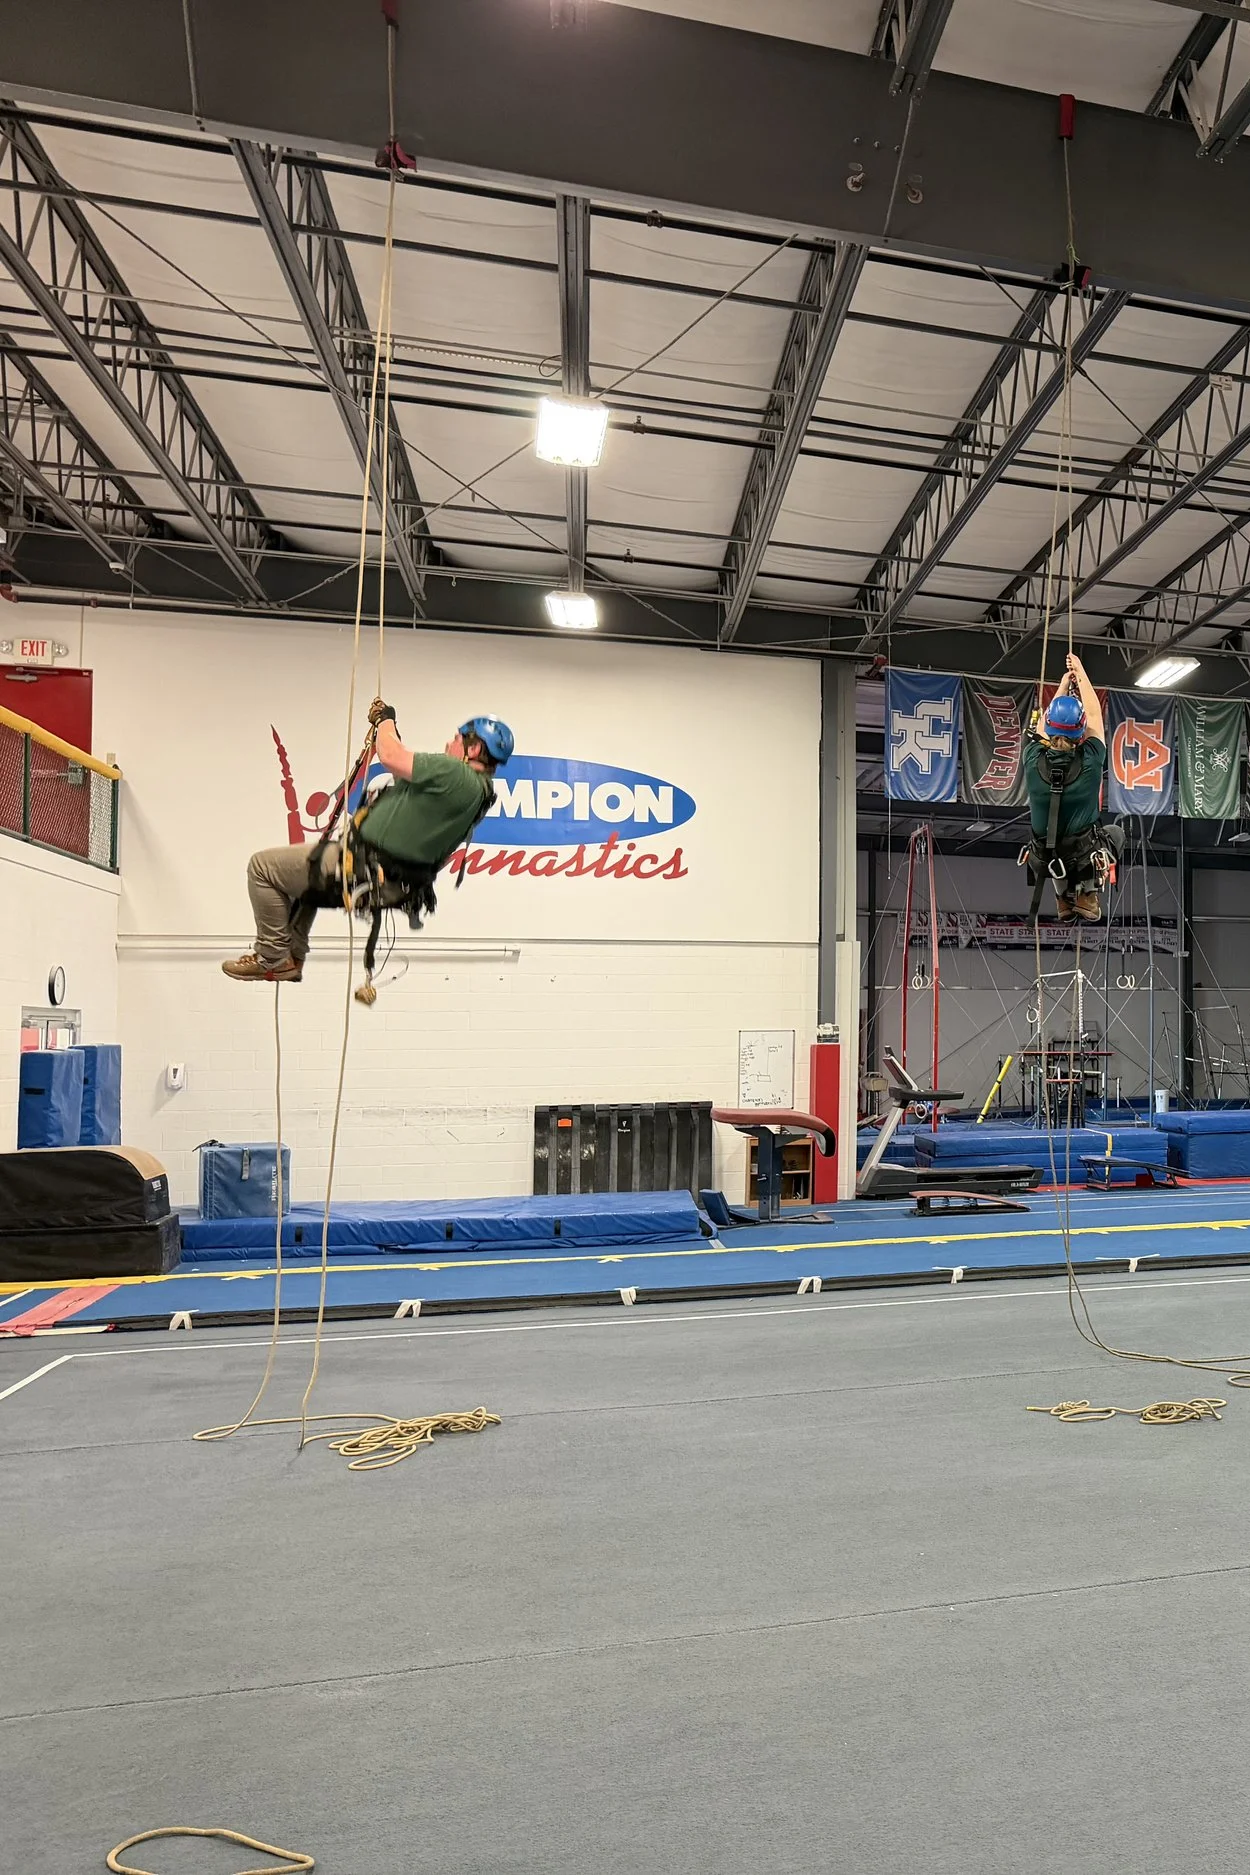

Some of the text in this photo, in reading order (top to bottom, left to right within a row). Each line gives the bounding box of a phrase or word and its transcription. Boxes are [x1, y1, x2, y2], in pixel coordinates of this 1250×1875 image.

[21, 640, 47, 657] EXIT
[1194, 705, 1208, 758] WILLIAM
[971, 692, 1022, 791] DENVER
[1195, 761, 1206, 773] &
[990, 928, 1014, 936] STATE
[1047, 929, 1070, 937] STATE
